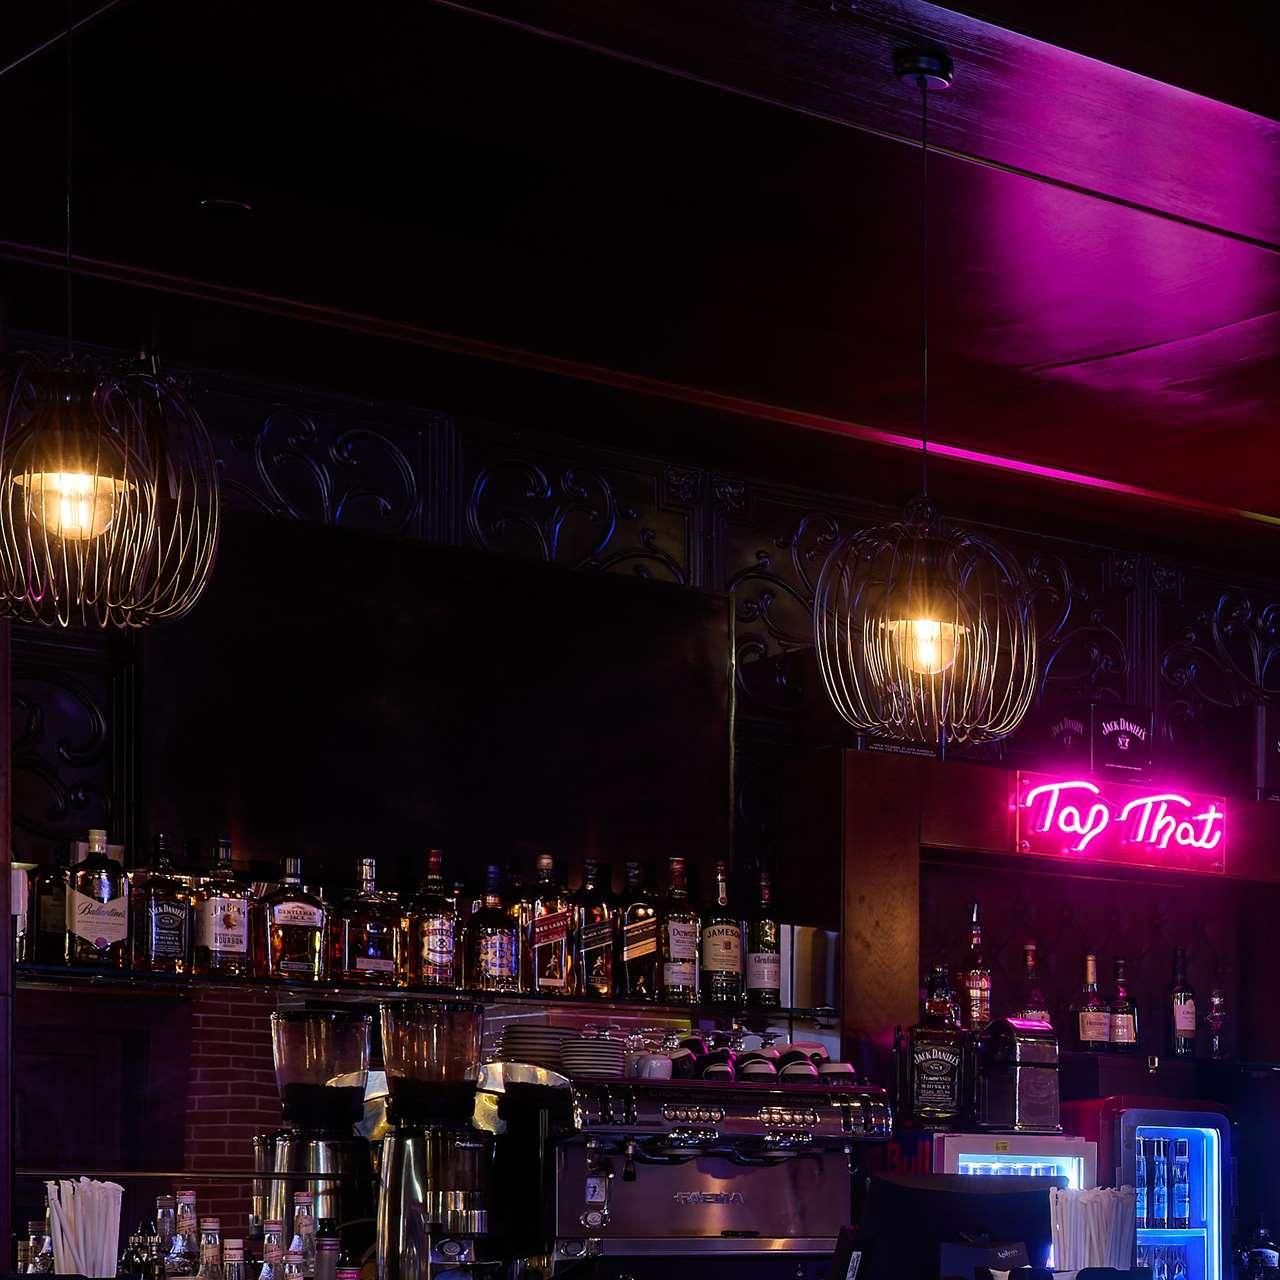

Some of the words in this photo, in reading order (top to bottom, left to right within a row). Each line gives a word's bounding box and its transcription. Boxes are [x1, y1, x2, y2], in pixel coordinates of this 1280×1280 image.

[1102, 720, 1119, 736] JACK
[1026, 780, 1109, 851] Tap
[1117, 793, 1224, 849] That
